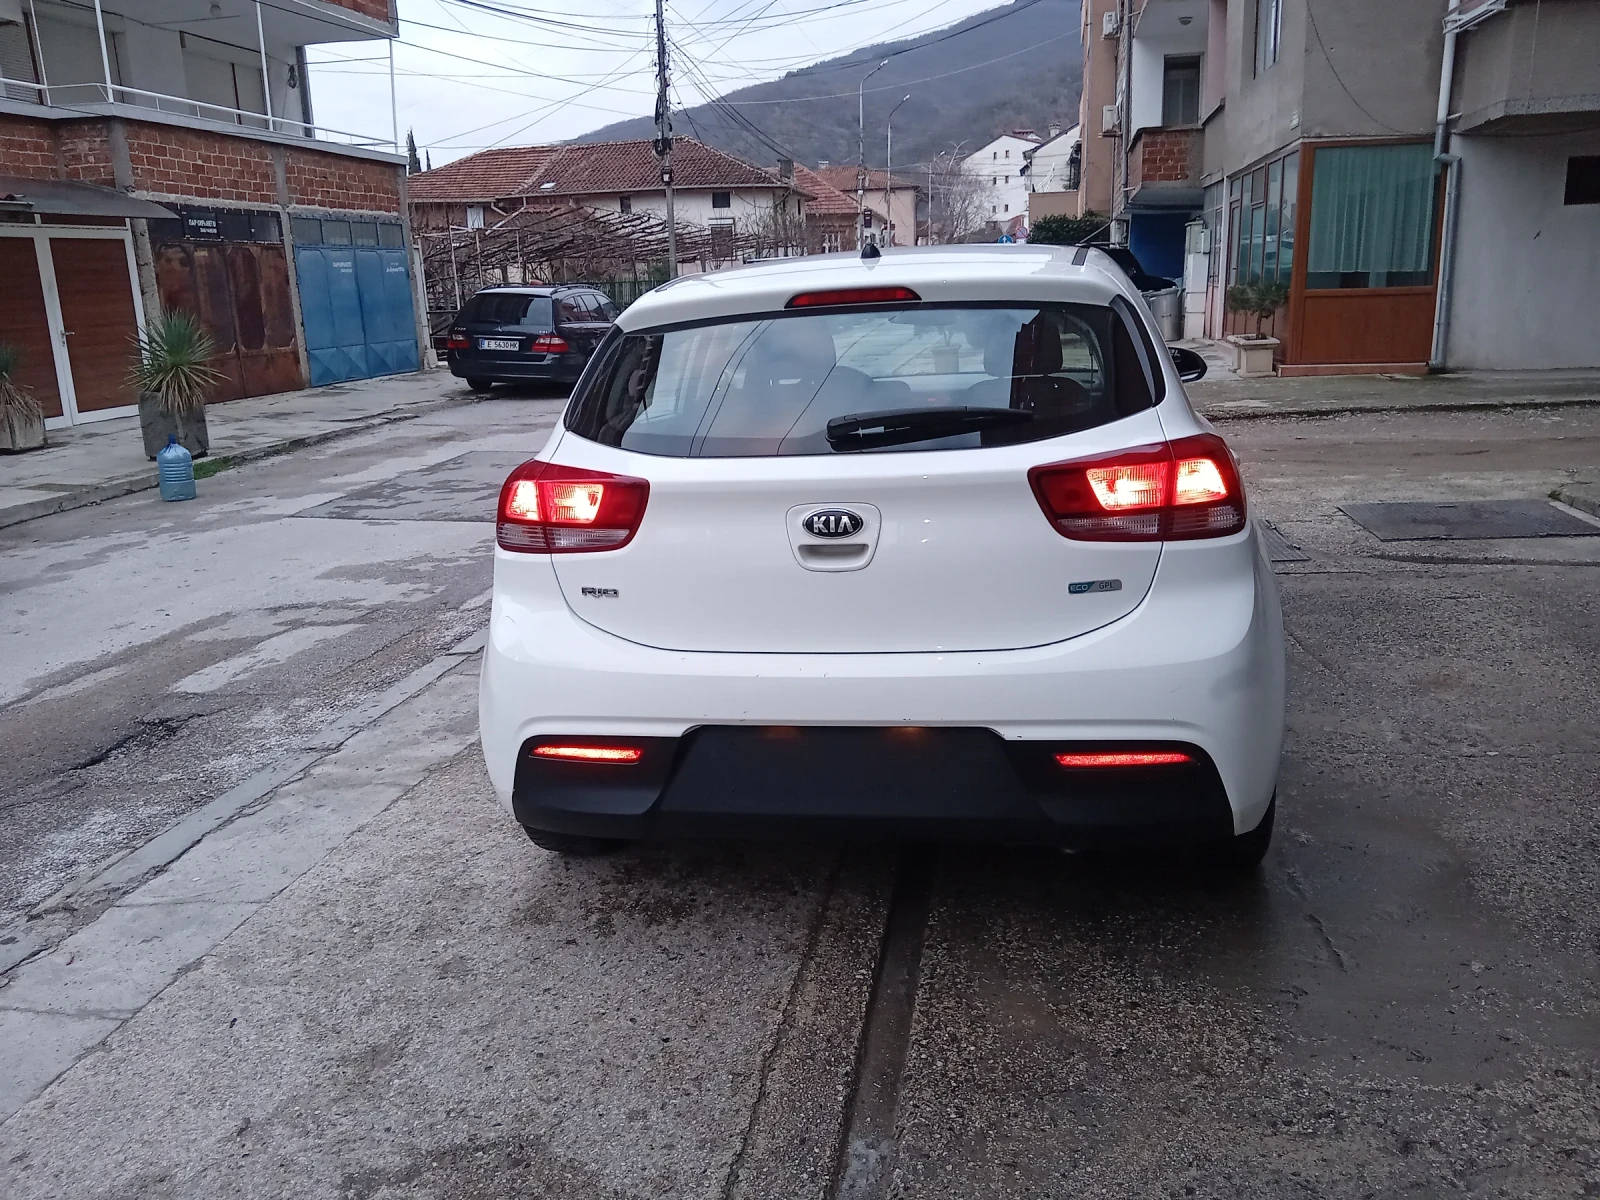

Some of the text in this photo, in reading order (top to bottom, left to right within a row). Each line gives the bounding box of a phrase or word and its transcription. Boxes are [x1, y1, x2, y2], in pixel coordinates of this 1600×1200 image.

[812, 515, 854, 533] KIA
[581, 586, 619, 598] RIO
[1070, 581, 1115, 592] ECO GPL
